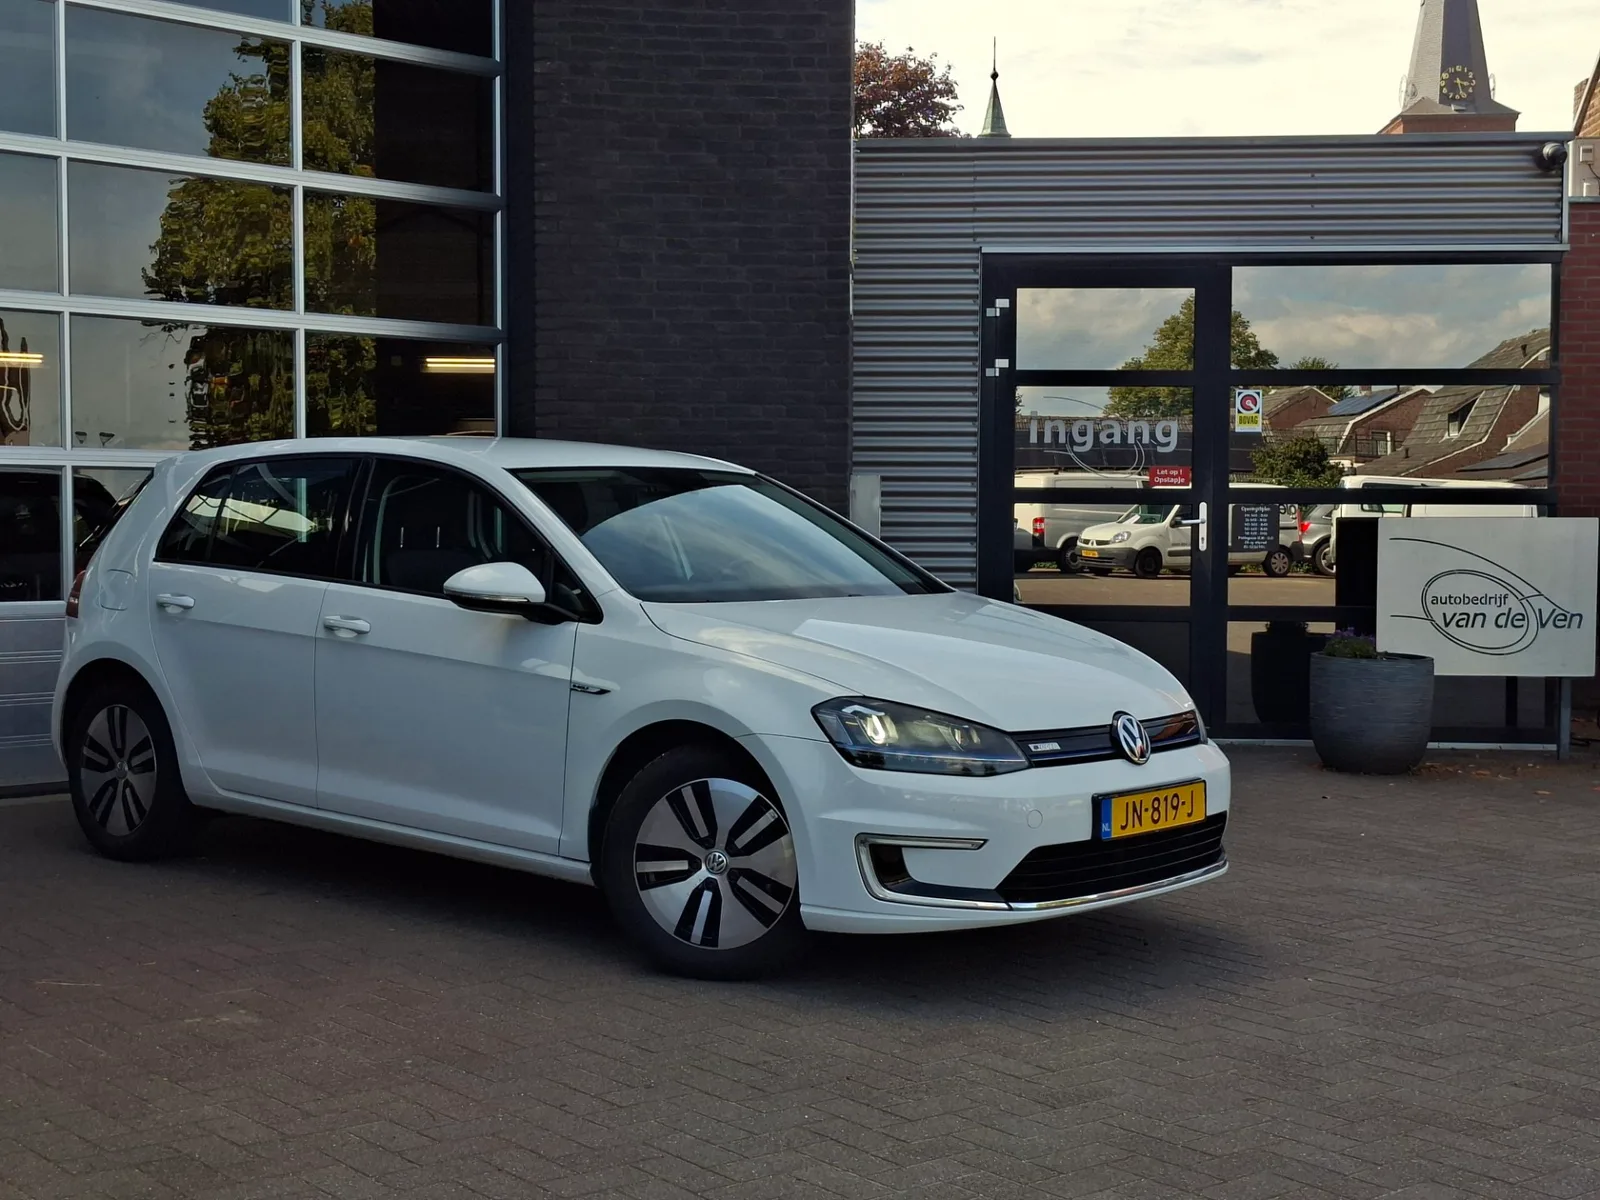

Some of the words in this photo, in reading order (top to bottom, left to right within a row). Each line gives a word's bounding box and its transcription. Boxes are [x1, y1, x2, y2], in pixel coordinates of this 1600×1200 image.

[1238, 415, 1259, 425] BOVAG
[1029, 411, 1178, 452] ingang
[1154, 476, 1186, 484] Opstapje
[1430, 593, 1509, 608] autobedrijf
[1441, 611, 1487, 629] van
[1494, 607, 1526, 629] de
[1537, 607, 1584, 629] Ven
[1101, 822, 1111, 832] NL
[1120, 789, 1195, 831] JN-819-J
